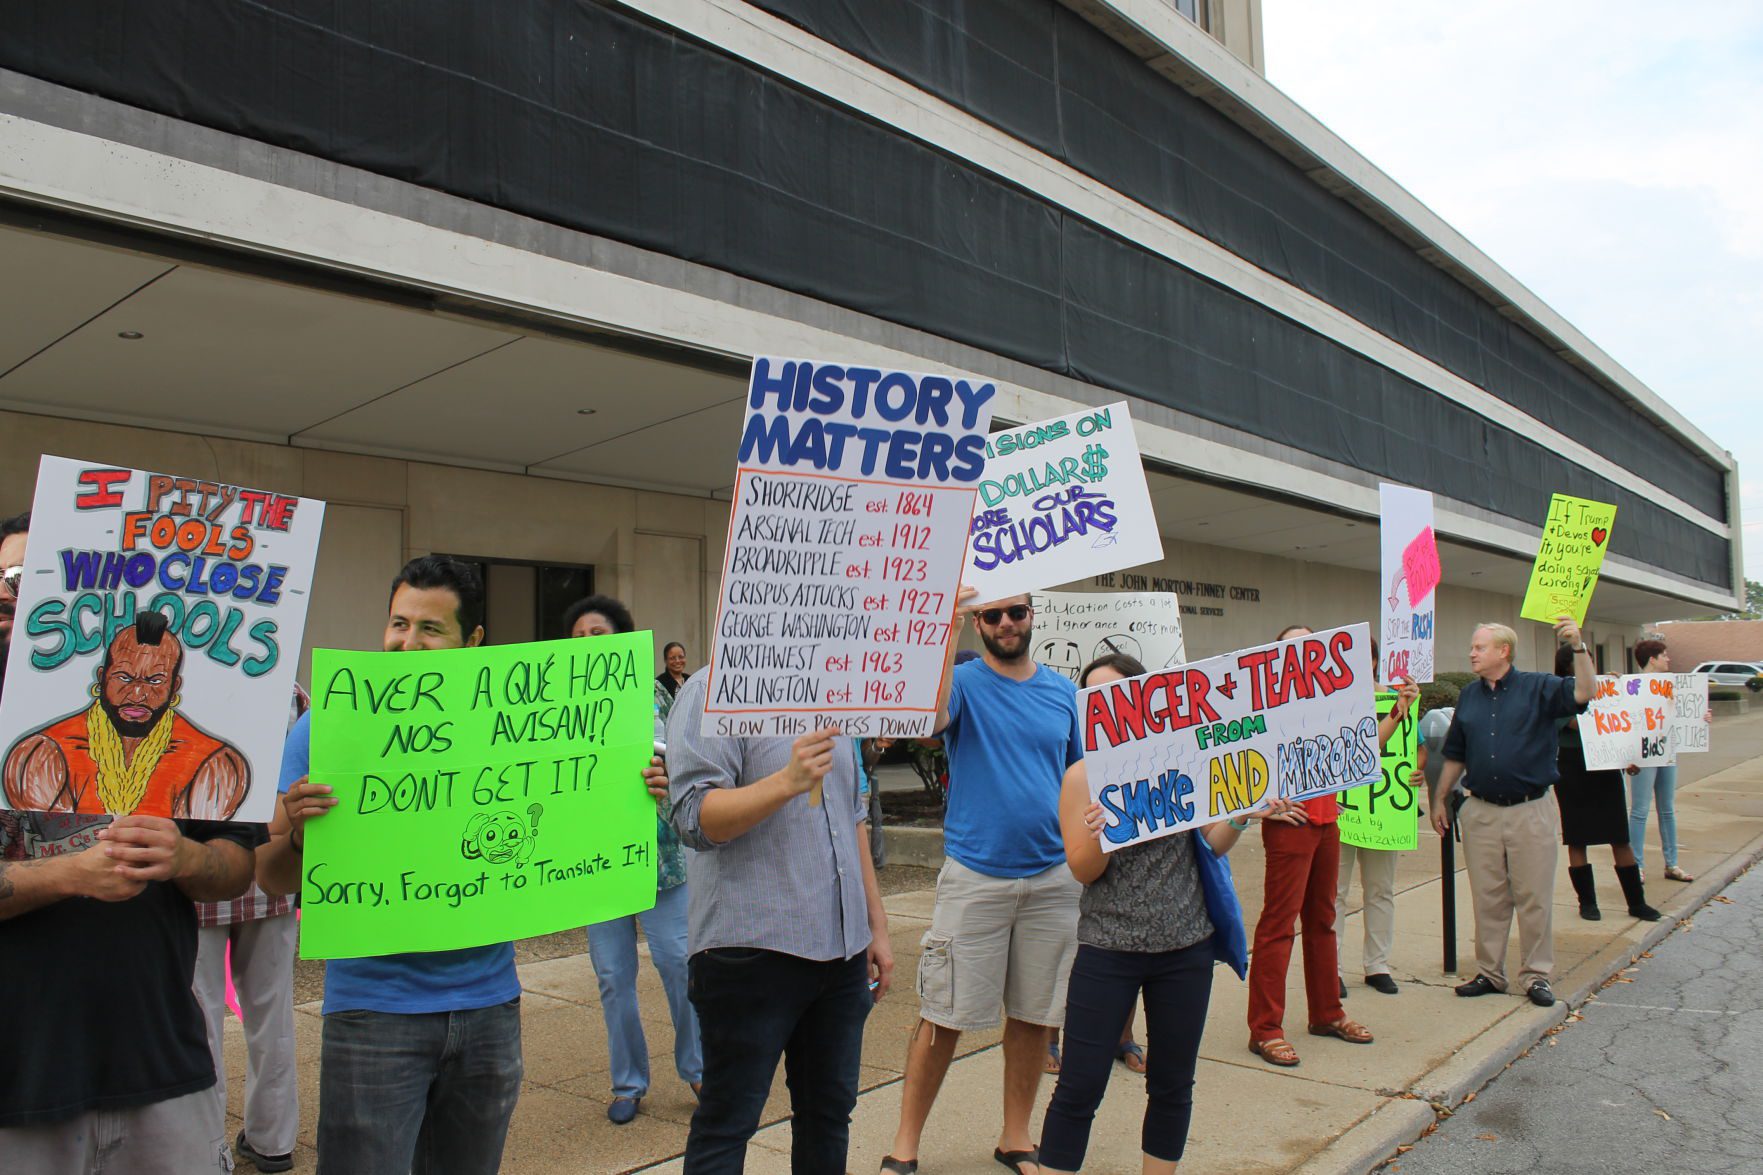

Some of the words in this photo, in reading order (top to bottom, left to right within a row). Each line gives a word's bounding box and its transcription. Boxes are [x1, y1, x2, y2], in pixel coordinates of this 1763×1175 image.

[750, 357, 996, 430] HISTORY
[737, 413, 987, 482] MATTERS
[985, 420, 1070, 459] ISIONS
[1076, 407, 1112, 437] ON
[979, 443, 1110, 508] DOLLAR$
[75, 470, 131, 510] I
[147, 474, 237, 523] PITY
[238, 491, 298, 530] THE
[745, 476, 858, 513] SHORTRIDGE
[895, 492, 934, 518] 1864
[1032, 485, 1107, 512] OUR
[1549, 498, 1573, 525] If
[1578, 504, 1609, 526] Trump
[122, 513, 254, 561] FOOLS
[737, 515, 812, 544] ARSENAL
[817, 518, 856, 546] TECH
[891, 524, 931, 550] 1912
[973, 500, 1118, 571] SCHOLARS
[62, 550, 156, 591] WHO
[159, 550, 288, 603] CLOSE
[731, 545, 843, 576] BROADRIPPLE
[882, 556, 927, 582] 1923
[1538, 561, 1572, 581] doing
[729, 580, 792, 606] CRISPUS
[790, 582, 860, 610] ATTUCKS
[898, 588, 945, 616] 1927
[1095, 572, 1115, 587] THE
[1120, 574, 1147, 590] JOHN
[1152, 577, 1226, 599] MORTON-FINNEY
[1229, 586, 1261, 602] CENTER
[721, 610, 777, 639] GEORGE
[780, 612, 871, 640] WASHINGTON
[906, 619, 951, 647] 1927
[1179, 605, 1197, 615] TIONAL
[1200, 607, 1224, 616] SERVICES
[1411, 610, 1433, 640] RUSH
[26, 591, 279, 677] SCHOOLS
[720, 643, 822, 671] NORTHWEST
[862, 651, 903, 674] 1963
[470, 666, 494, 711] A
[504, 652, 555, 706] QUÉ
[569, 649, 638, 698] HORA
[716, 674, 820, 705] ARLINGTON
[864, 680, 906, 704] 1968
[1086, 669, 1221, 751] ANGER
[1238, 632, 1353, 712] TEARS
[1626, 679, 1641, 696] OF
[1650, 679, 1673, 700] OUR
[380, 721, 454, 758] NOS
[716, 716, 765, 737] SLOW
[770, 714, 807, 736] THIS
[879, 715, 928, 737] DOWN!
[1195, 714, 1267, 750] FROM
[1594, 709, 1632, 736] KIDS
[1645, 707, 1665, 730] B4
[358, 770, 461, 815] DON'T
[472, 760, 539, 806] GET
[550, 753, 598, 796] IT?
[1209, 749, 1269, 817] AND
[1344, 831, 1411, 846] ivatization
[1370, 818, 1383, 831] by
[400, 870, 490, 908] Forgot
[500, 873, 527, 890] to
[534, 852, 613, 887] Translate
[622, 840, 650, 868] It!
